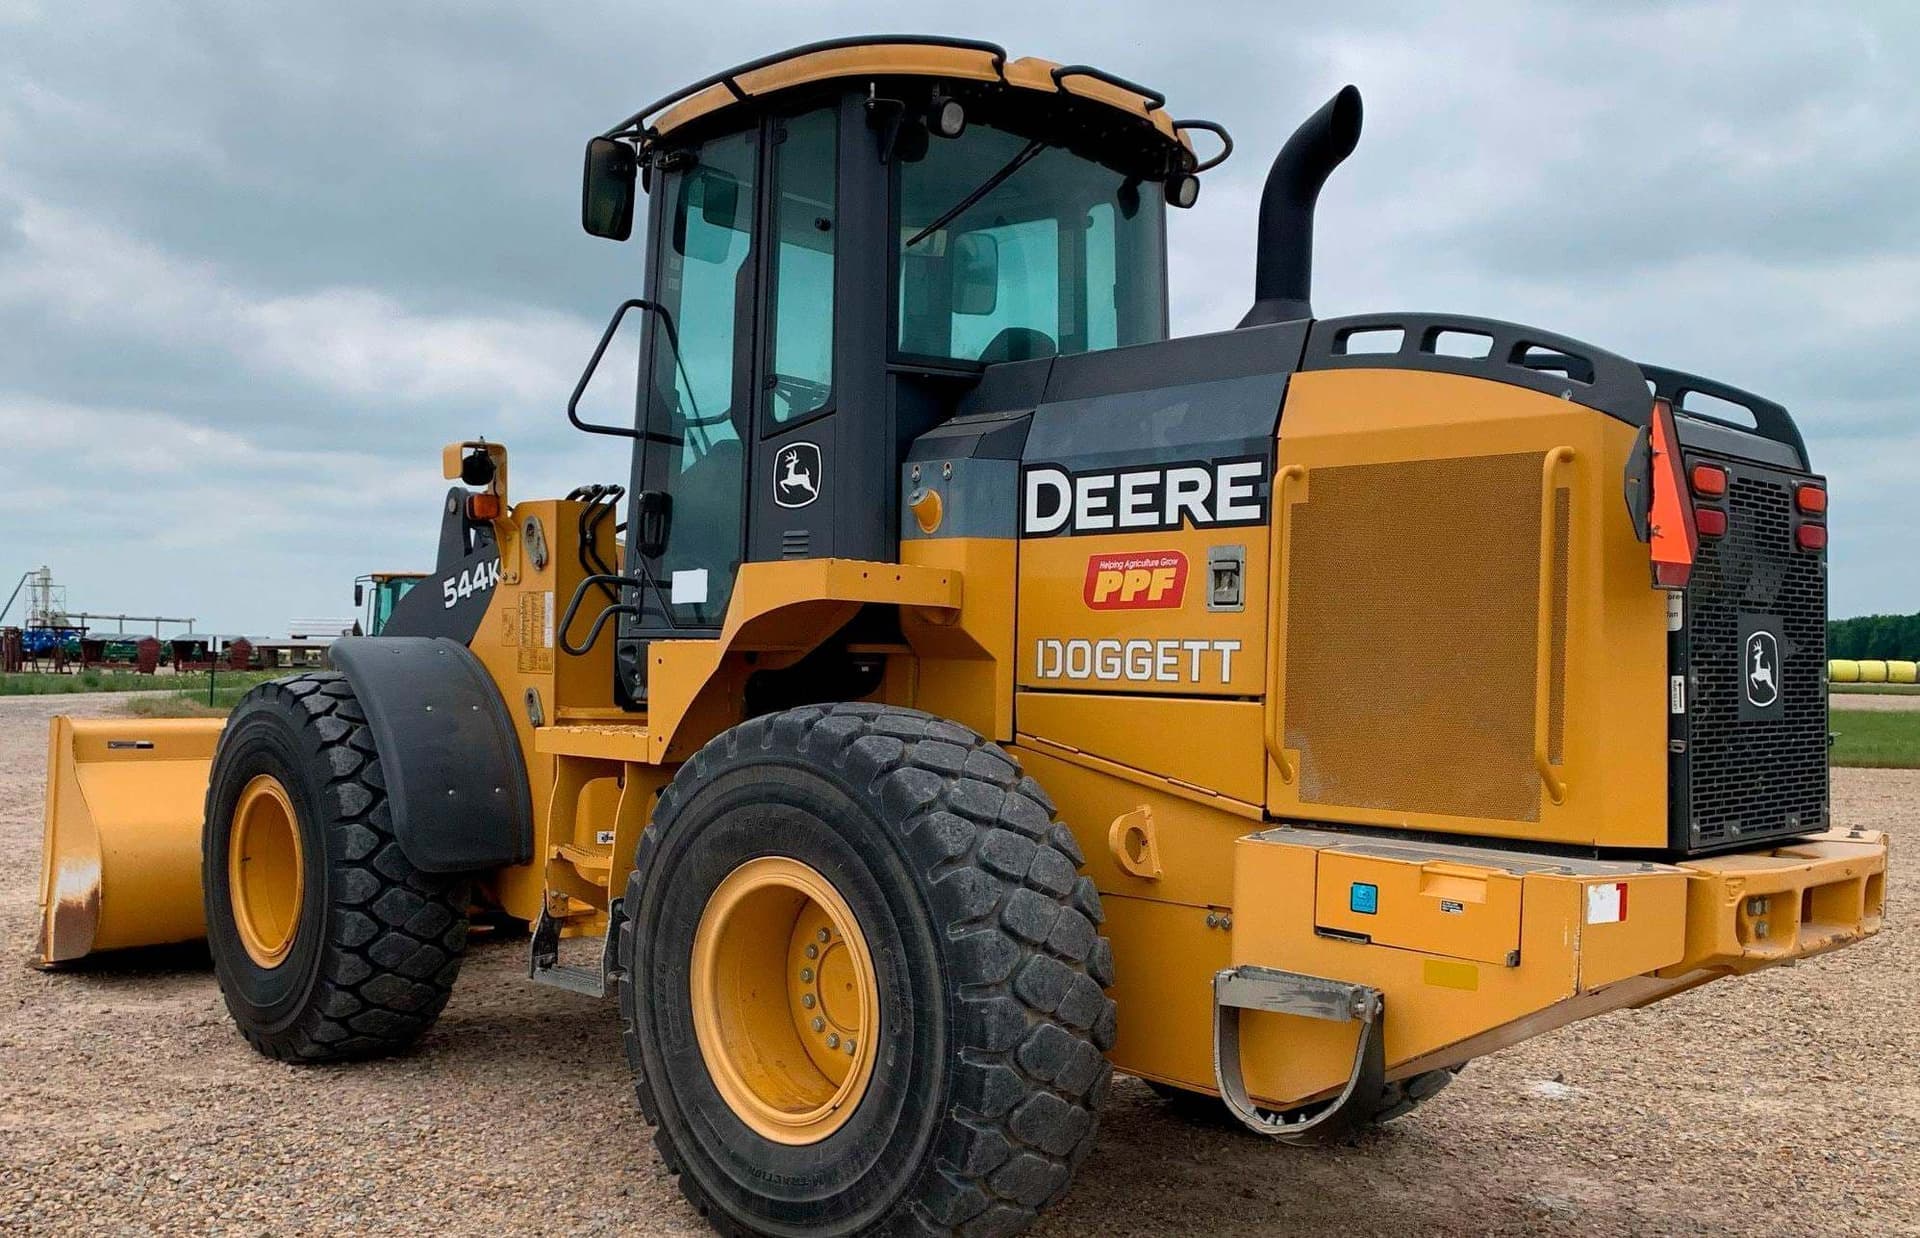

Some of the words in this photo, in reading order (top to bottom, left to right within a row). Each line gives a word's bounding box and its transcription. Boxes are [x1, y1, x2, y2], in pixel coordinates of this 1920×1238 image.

[1025, 461, 1263, 533] DEERE
[443, 558, 501, 609] 544K
[1093, 567, 1177, 602] PPF
[1099, 560, 1124, 570] Helping
[1124, 558, 1160, 569] Agriculture
[1160, 557, 1178, 567] Grow
[1036, 638, 1242, 684] DOGGETT
